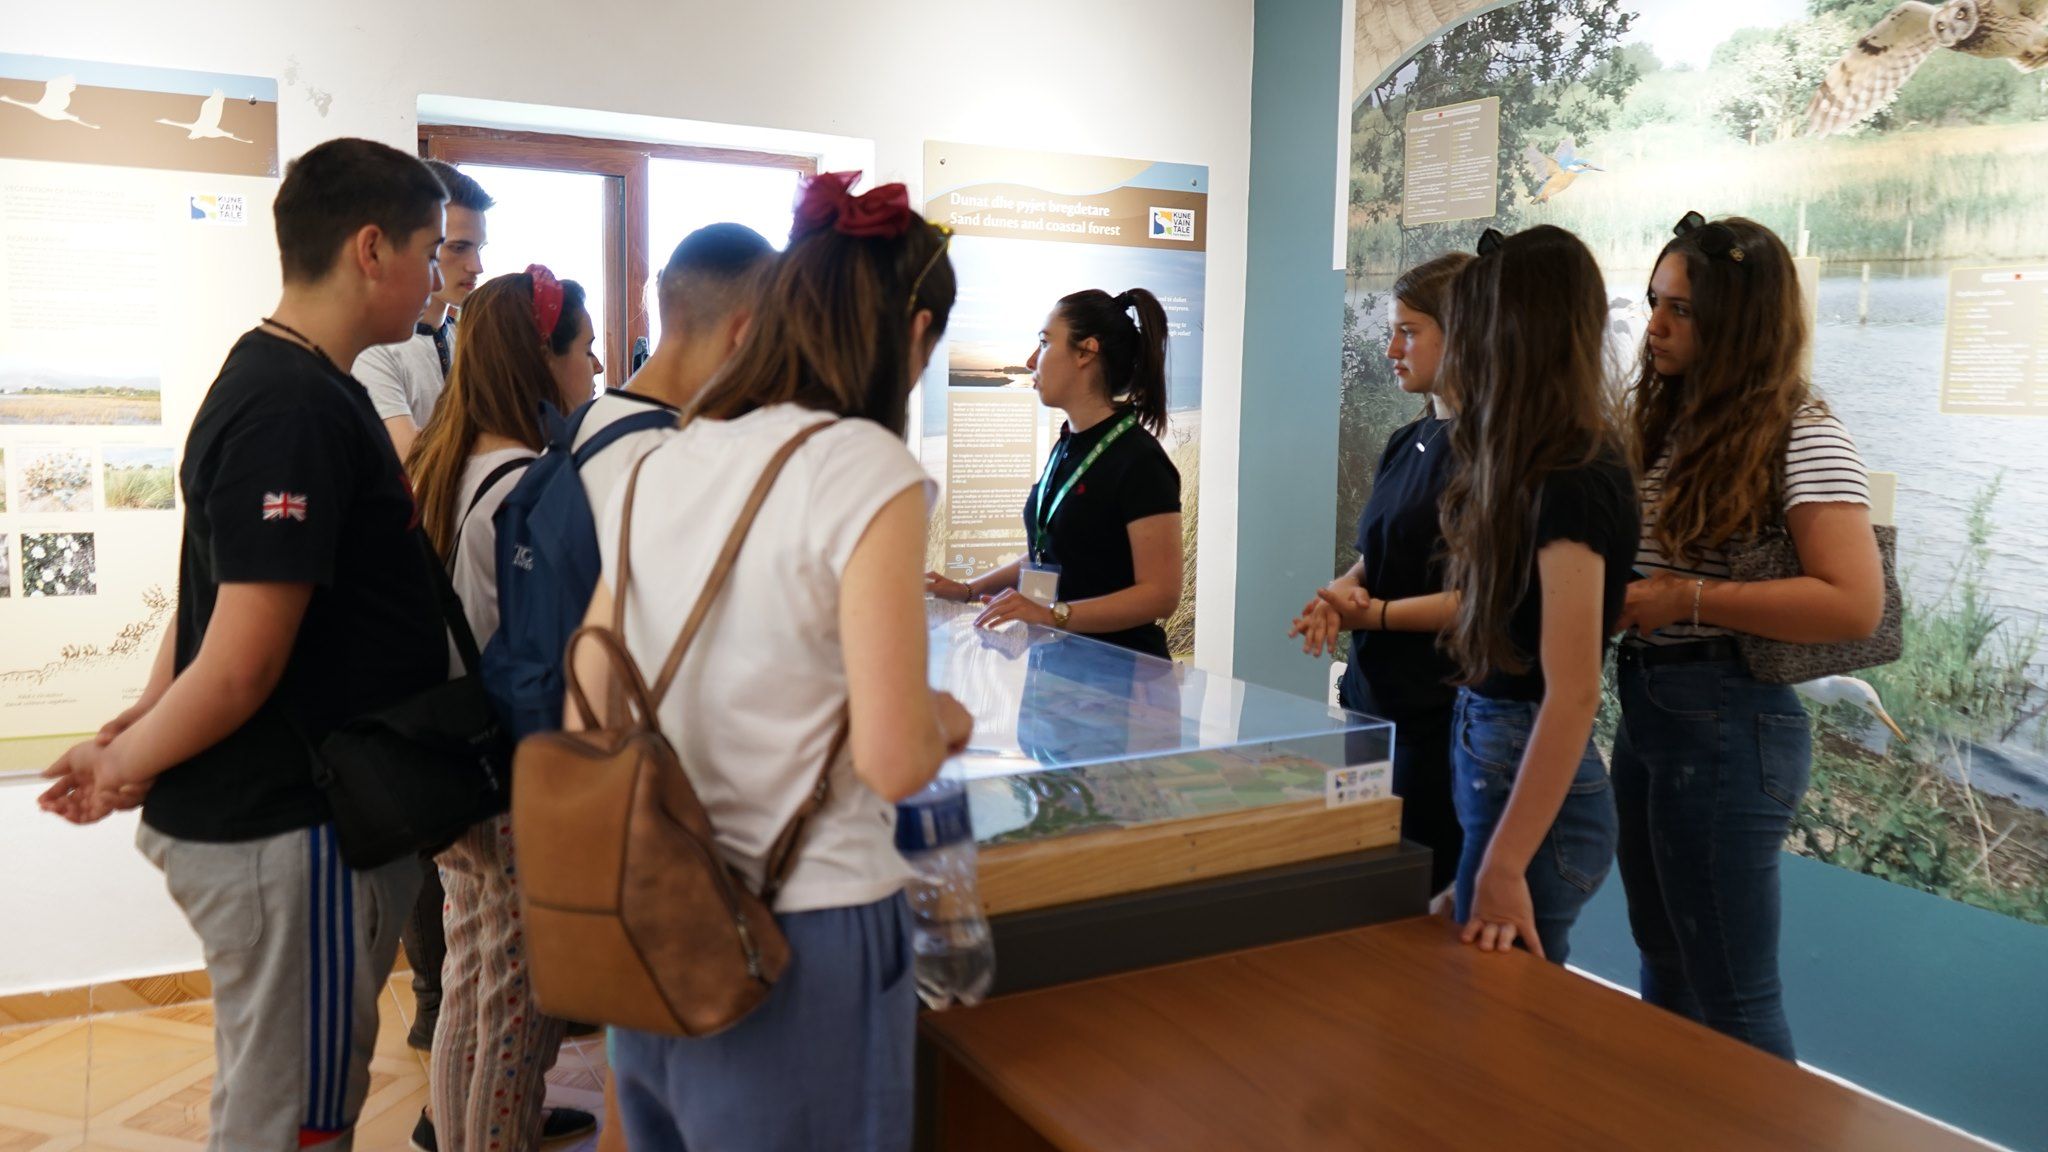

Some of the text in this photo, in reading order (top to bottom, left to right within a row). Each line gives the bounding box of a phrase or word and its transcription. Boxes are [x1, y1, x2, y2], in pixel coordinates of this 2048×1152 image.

[219, 211, 242, 219] TALE
[950, 192, 1110, 217] Dunat dhe pyjet bregdetare
[950, 212, 1121, 236] Sand dunes and coastal forest
